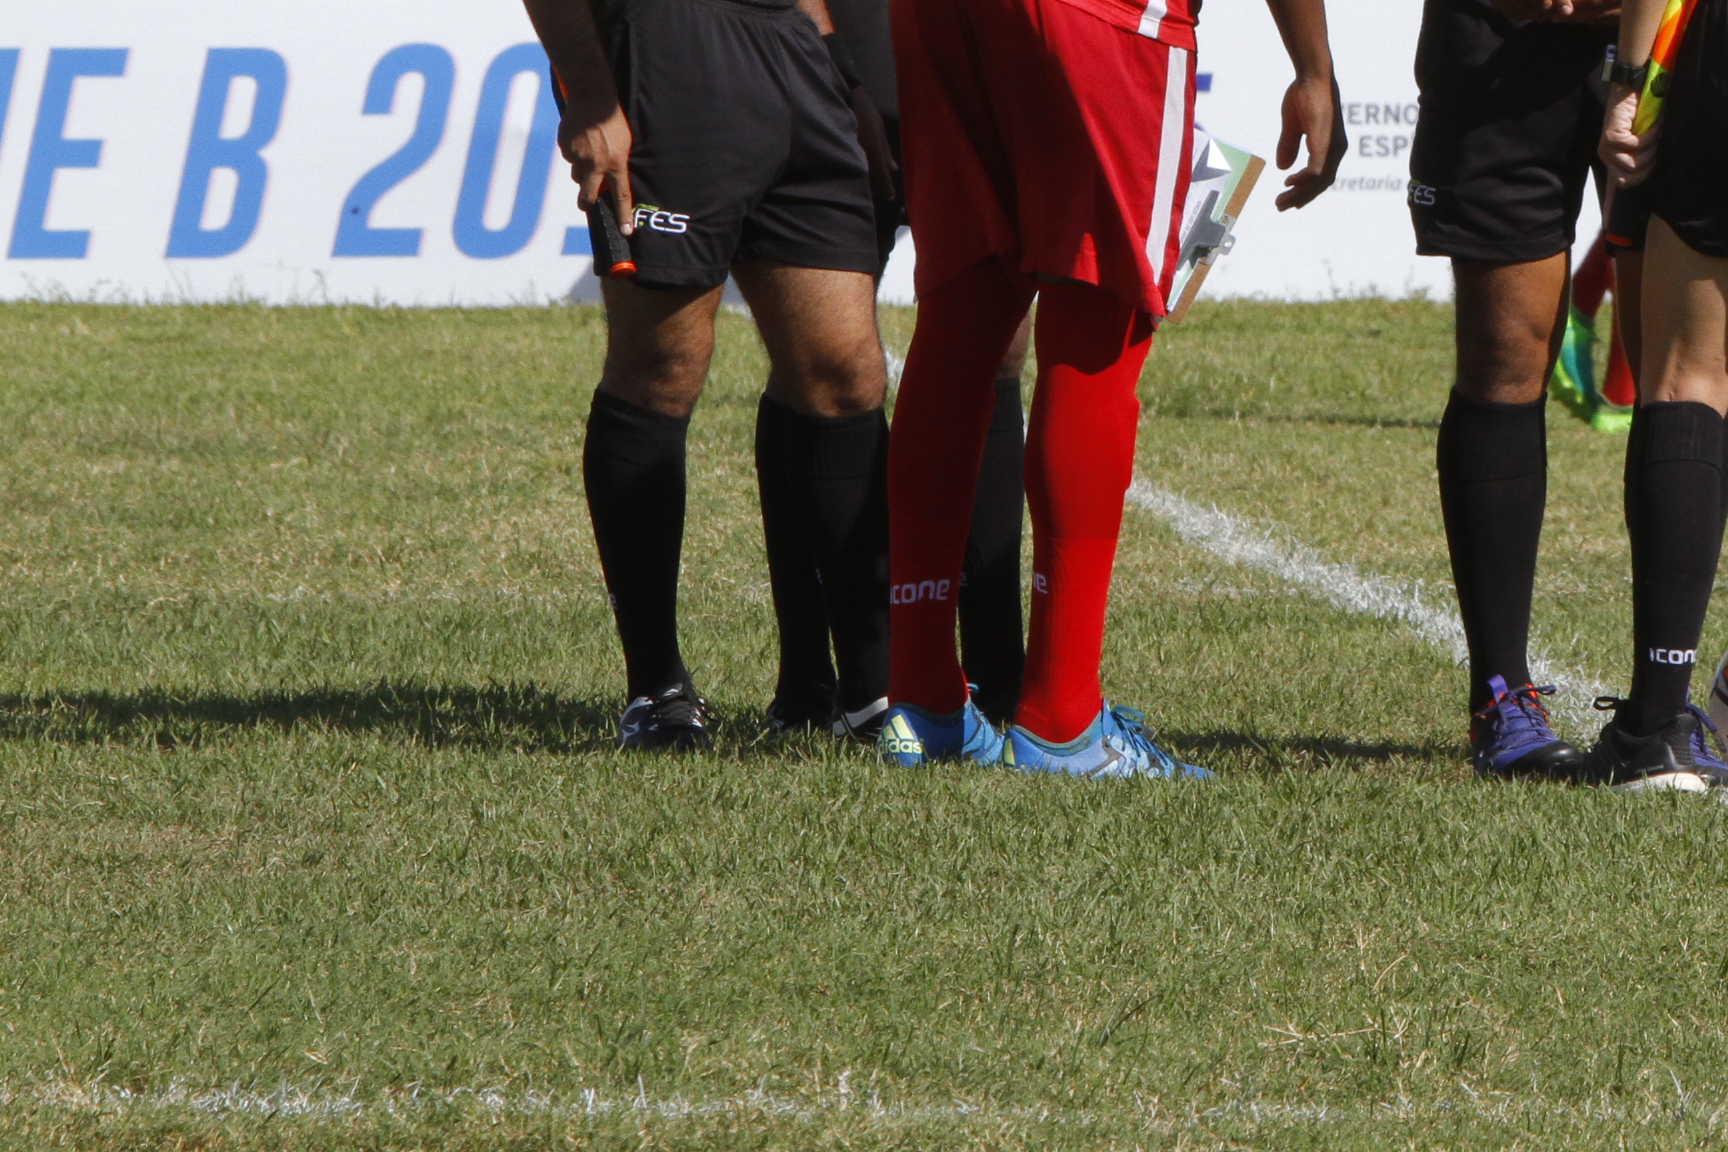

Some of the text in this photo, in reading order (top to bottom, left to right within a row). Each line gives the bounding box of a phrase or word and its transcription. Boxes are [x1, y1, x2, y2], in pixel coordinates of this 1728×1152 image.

[1341, 100, 1420, 126] ERNO
[164, 47, 289, 259] B
[330, 42, 594, 259] 20
[1358, 134, 1416, 158] ESP
[632, 203, 690, 234] FES
